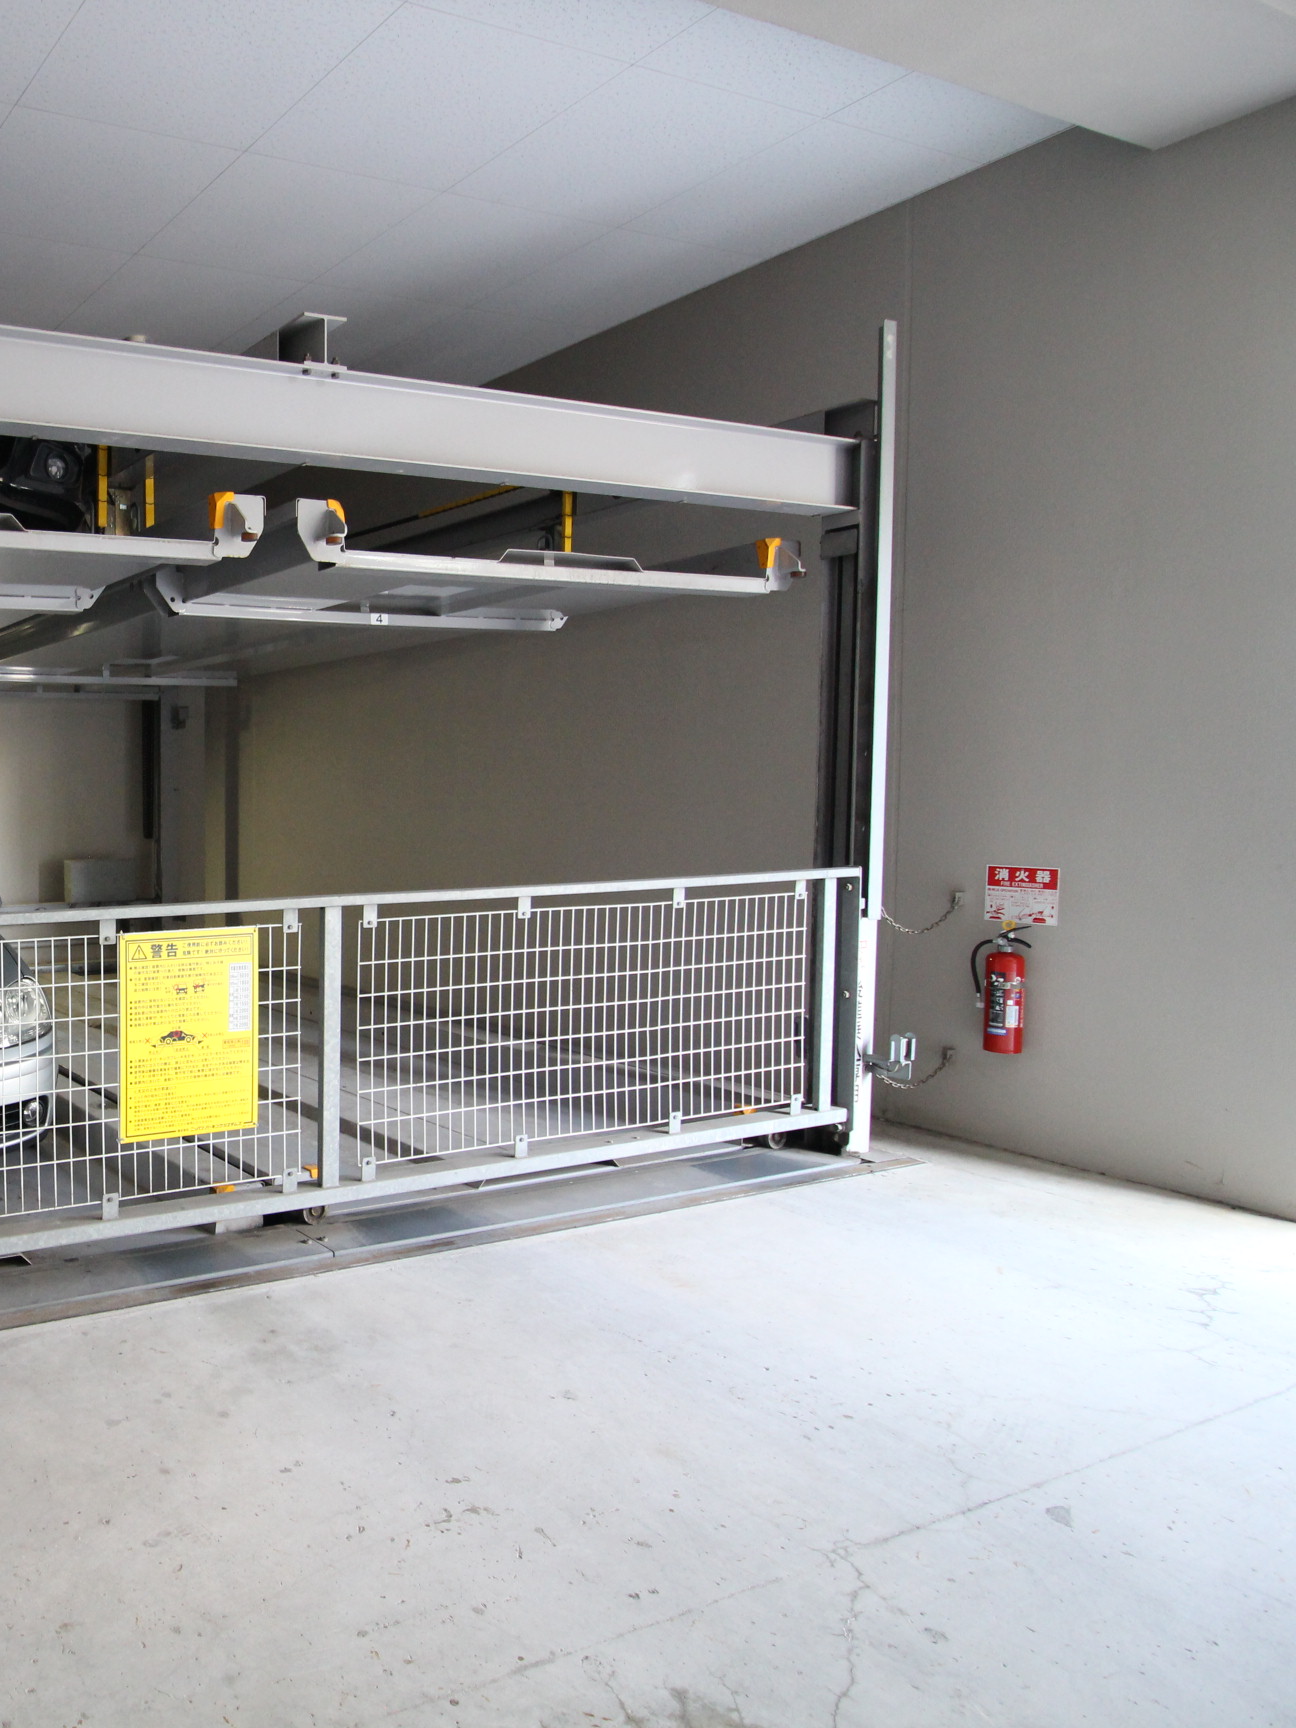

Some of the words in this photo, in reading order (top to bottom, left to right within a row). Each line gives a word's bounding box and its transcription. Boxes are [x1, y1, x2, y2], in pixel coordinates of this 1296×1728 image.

[376, 614, 383, 623] 4
[994, 868, 1051, 883] 消火器
[150, 943, 179, 959] 警告
